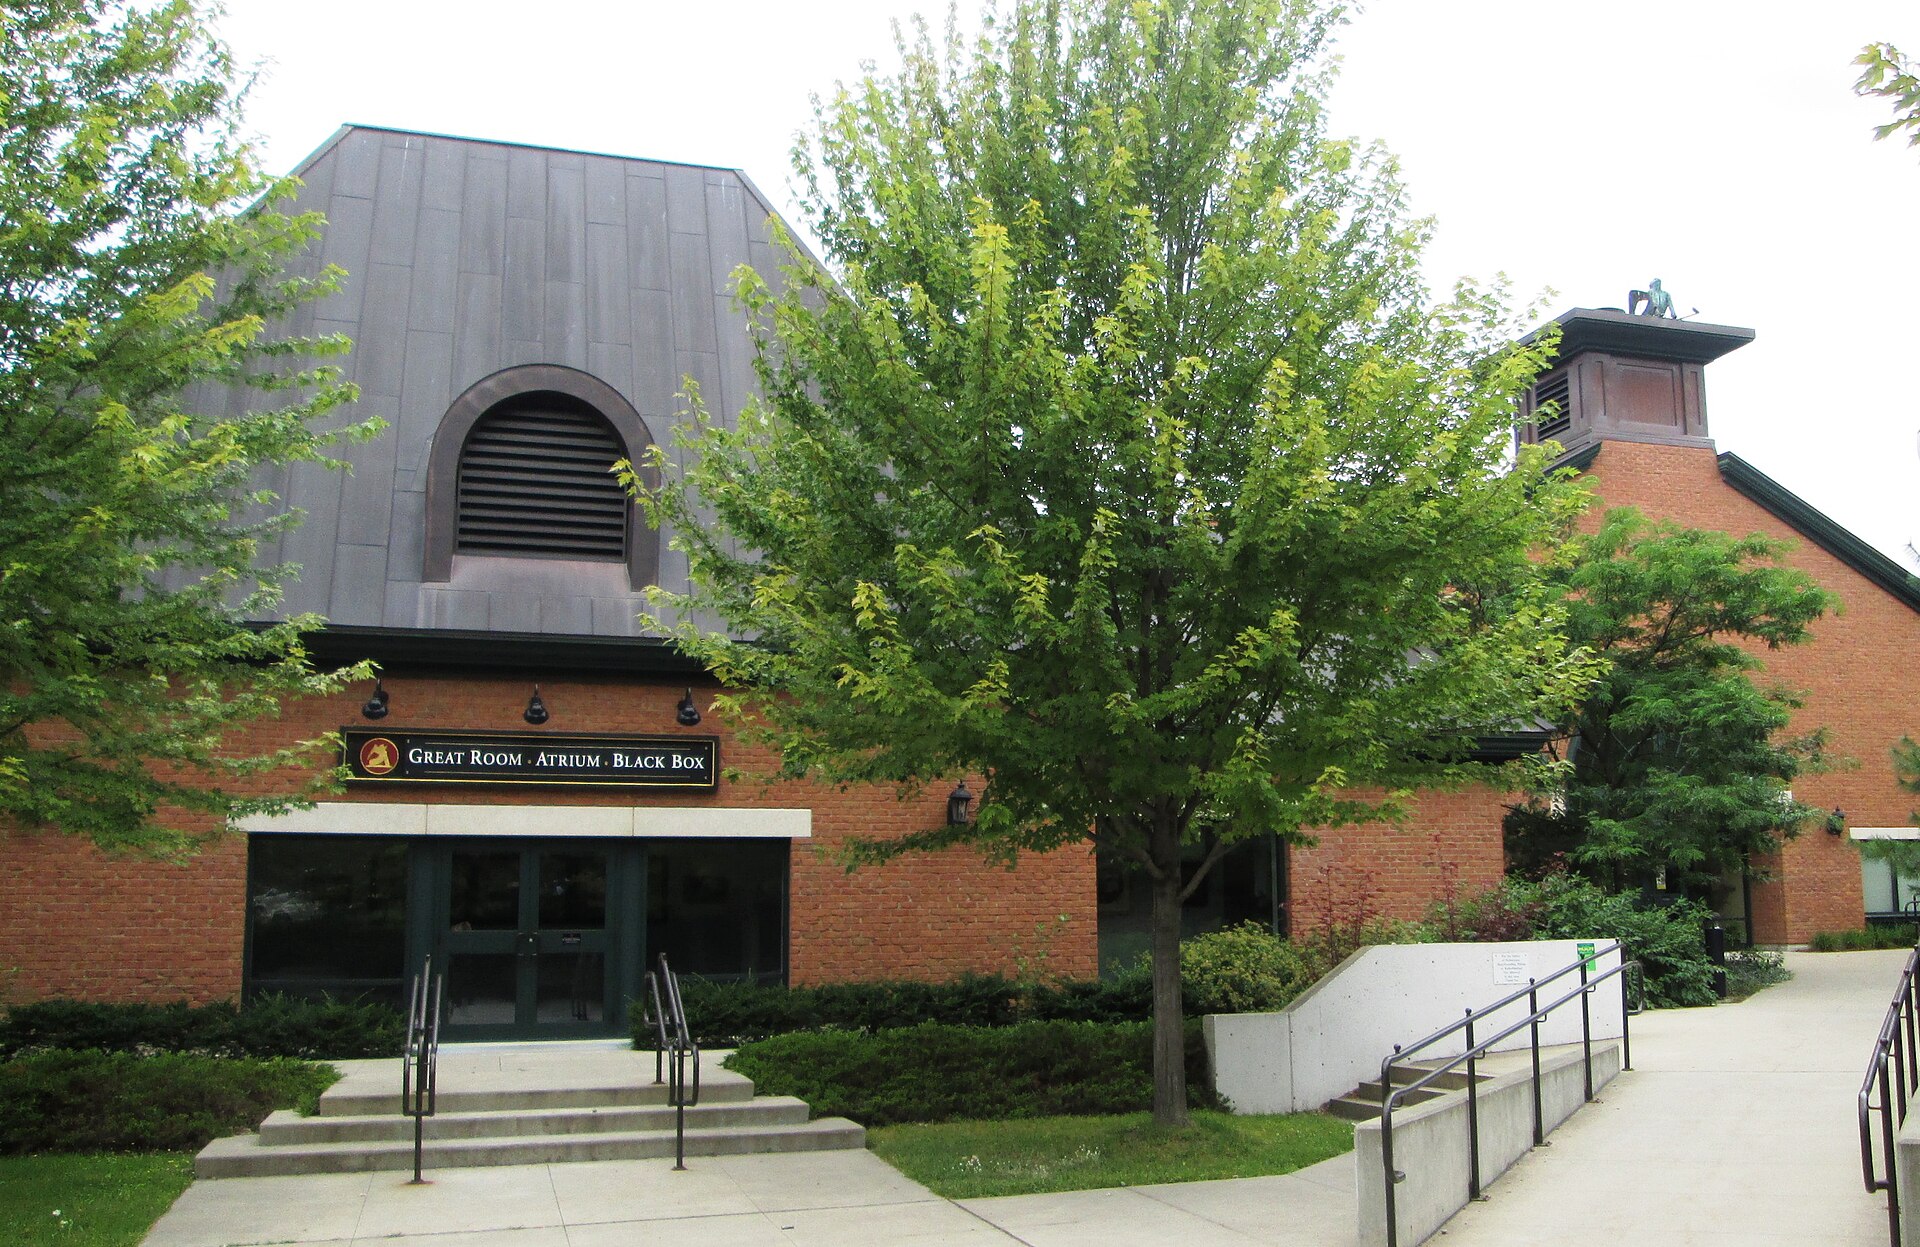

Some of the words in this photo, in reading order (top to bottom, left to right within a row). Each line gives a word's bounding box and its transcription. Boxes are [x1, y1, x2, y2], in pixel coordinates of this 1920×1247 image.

[408, 748, 465, 765] GREAT
[470, 750, 523, 767] ROOM
[535, 751, 601, 768] ATRIUM
[612, 753, 665, 769] BLACK
[671, 754, 705, 770] BOX
